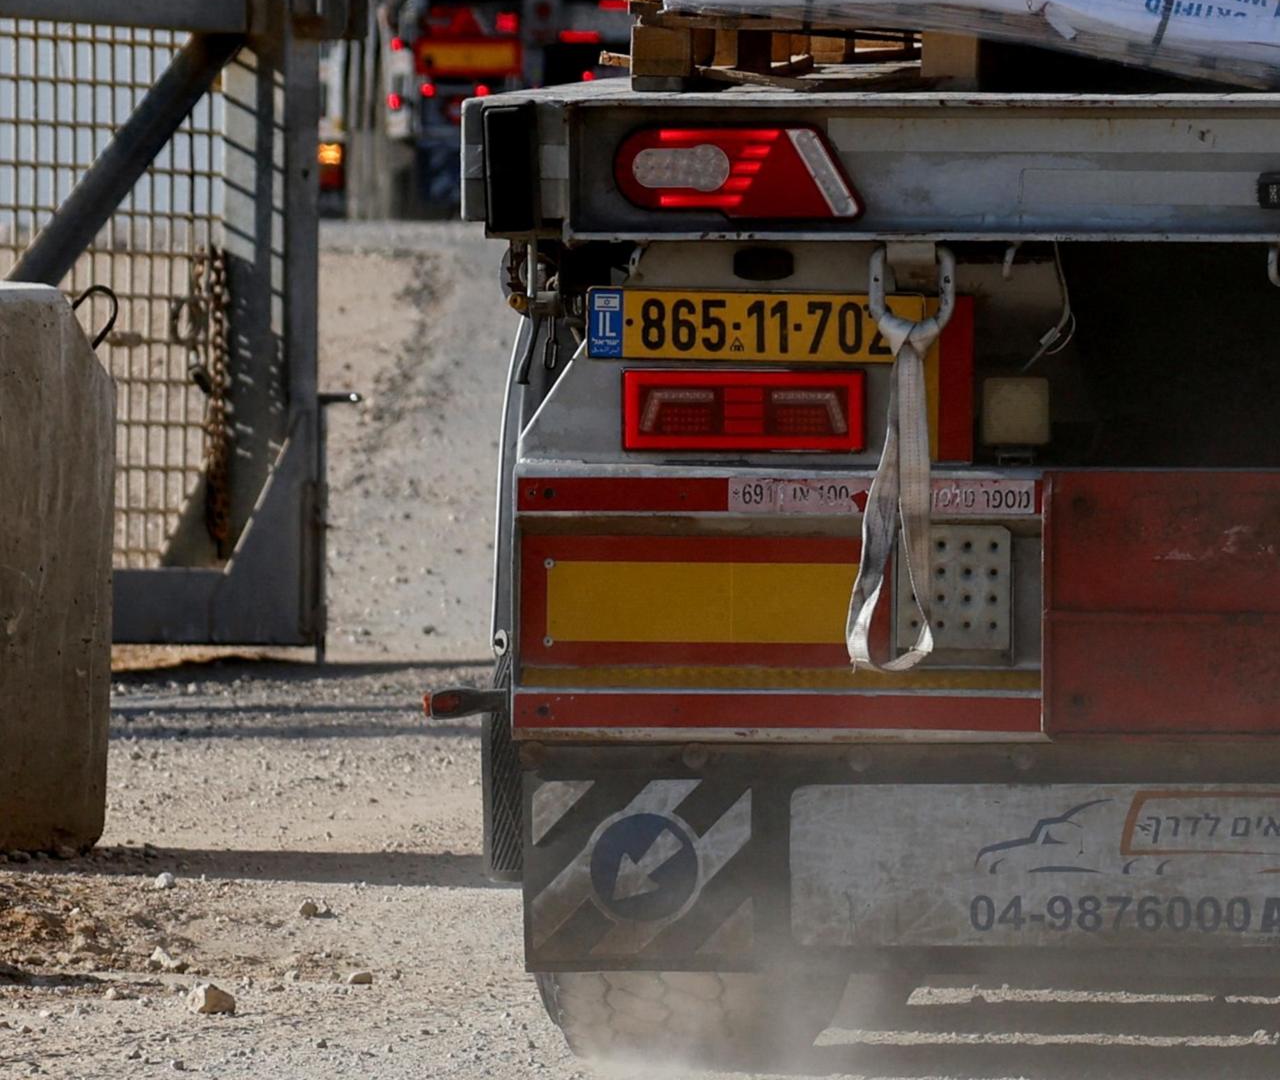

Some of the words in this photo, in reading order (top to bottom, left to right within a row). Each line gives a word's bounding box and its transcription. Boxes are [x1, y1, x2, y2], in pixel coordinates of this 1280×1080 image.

[599, 312, 616, 337] IL
[982, 491, 1030, 512] מספר
[1149, 812, 1220, 842] לדרך
[970, 895, 1251, 931] 04-9876000
